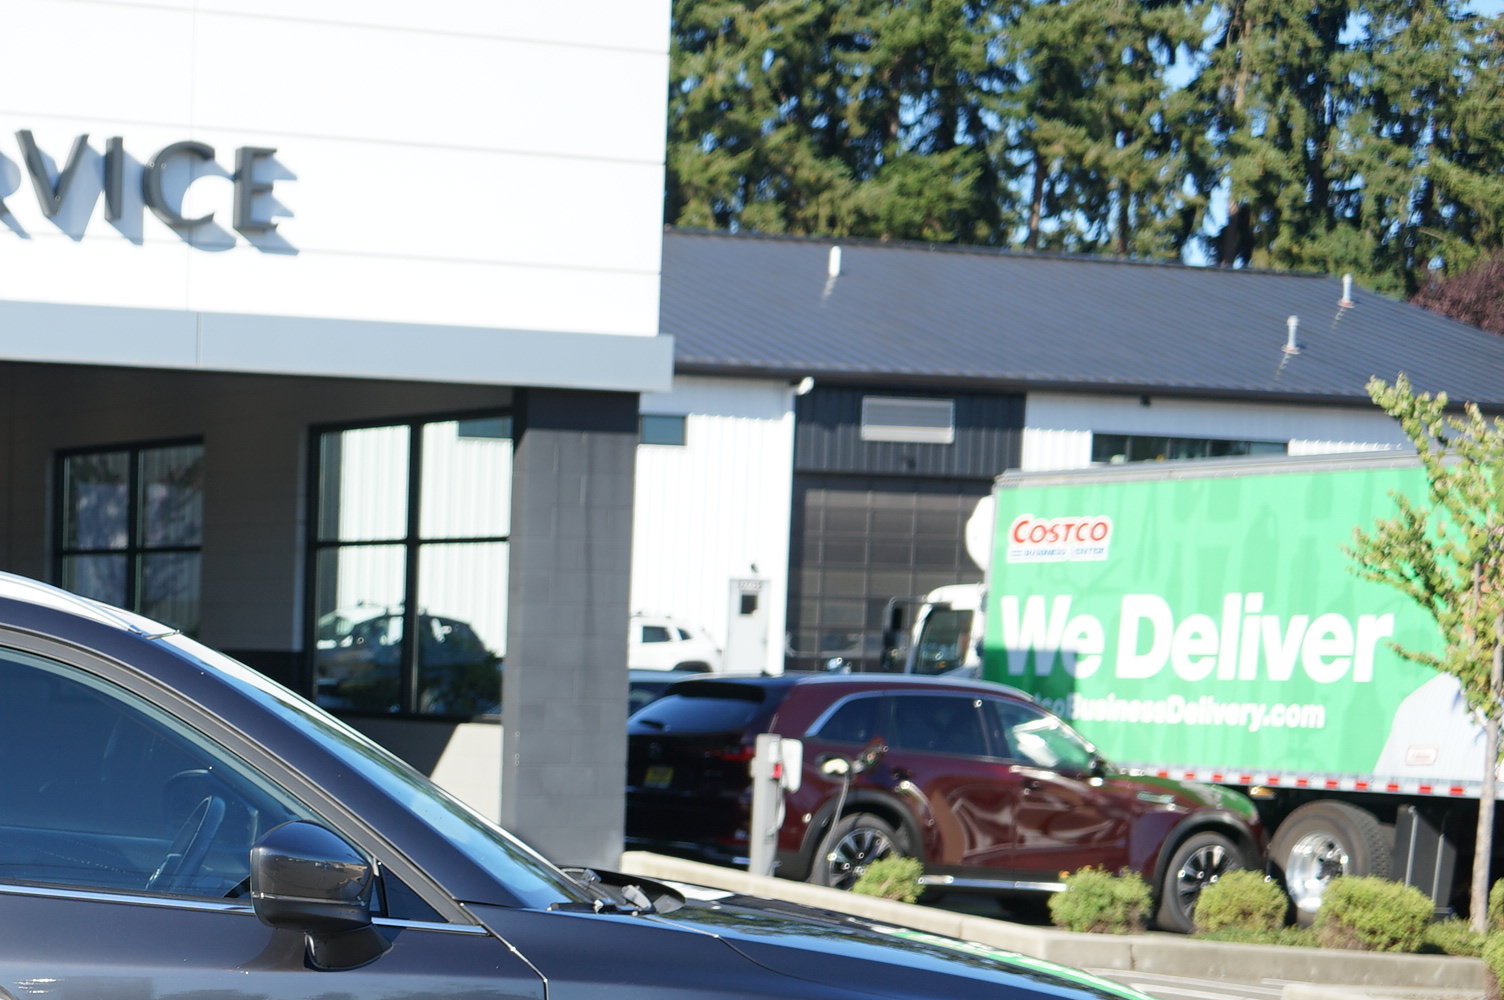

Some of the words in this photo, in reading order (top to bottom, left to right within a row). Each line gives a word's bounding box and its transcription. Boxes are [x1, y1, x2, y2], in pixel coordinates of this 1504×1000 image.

[1013, 519, 1109, 544] COSTCO
[1000, 594, 1105, 679] We
[1115, 592, 1395, 684] Deliver
